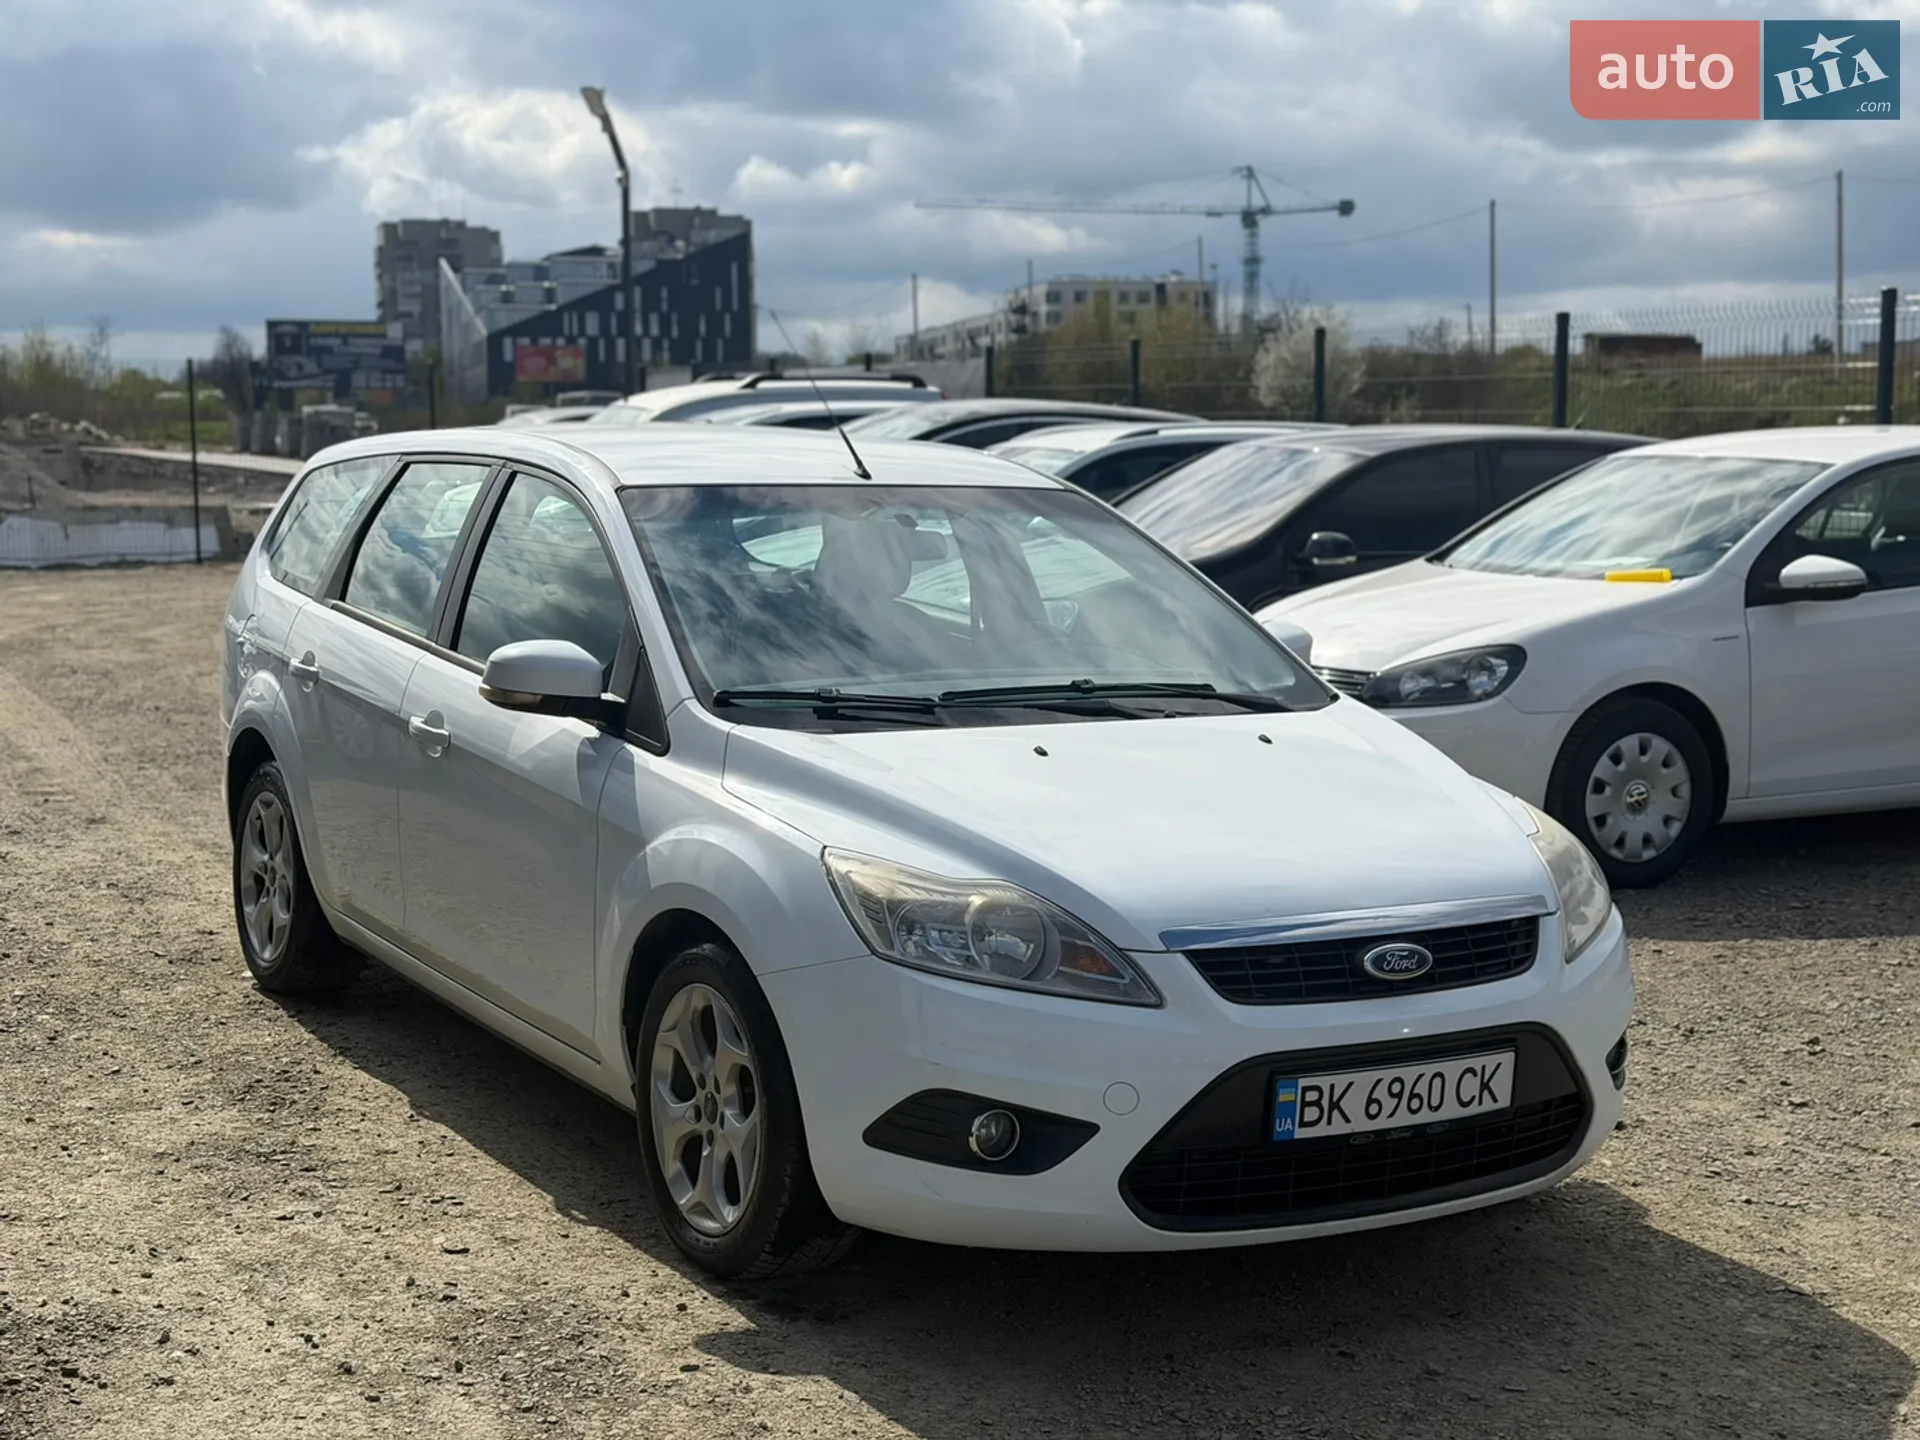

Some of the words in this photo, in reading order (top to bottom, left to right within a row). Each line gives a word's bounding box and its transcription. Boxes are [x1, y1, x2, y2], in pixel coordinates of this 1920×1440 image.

[1383, 950, 1419, 971] Ford
[1297, 1080, 1355, 1129] BK
[1364, 1070, 1446, 1121] 6960
[1455, 1061, 1503, 1108] CK
[1275, 1117, 1293, 1132] UA
